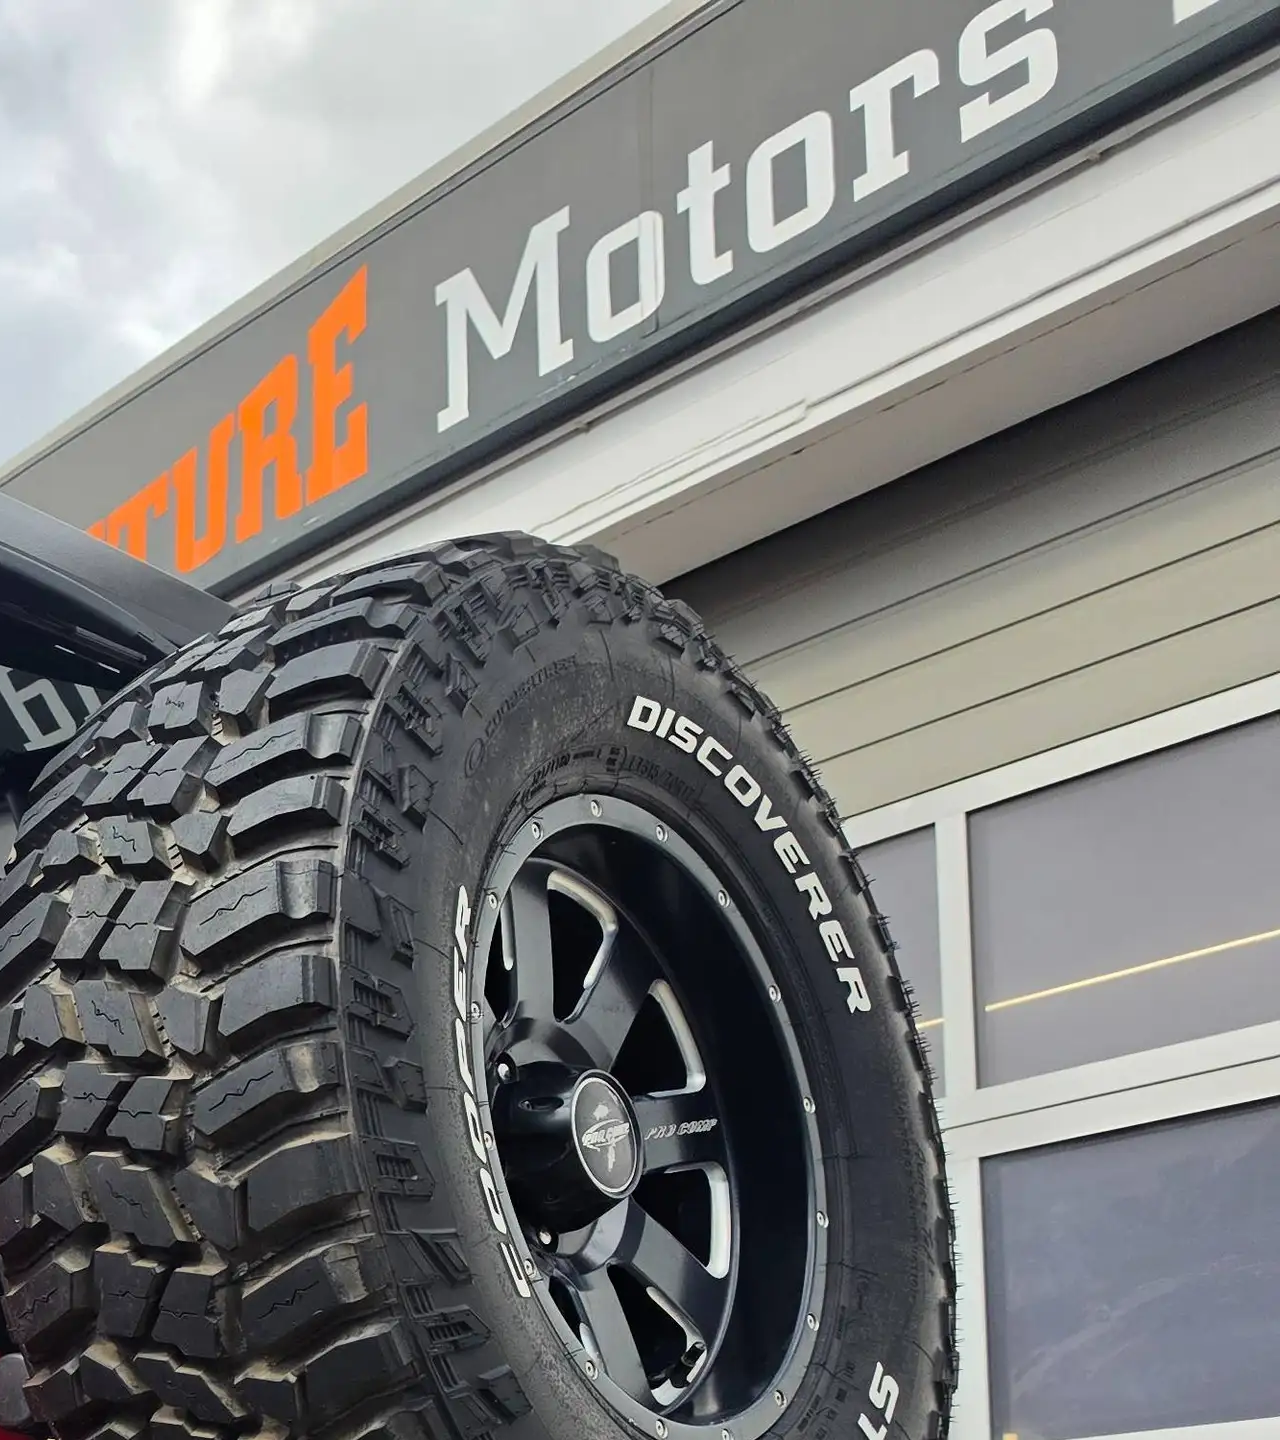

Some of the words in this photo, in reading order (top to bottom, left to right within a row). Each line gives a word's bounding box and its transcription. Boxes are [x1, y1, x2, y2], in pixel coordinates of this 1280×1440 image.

[86, 263, 368, 573] TURE
[435, 0, 1058, 433] Motors
[627, 695, 871, 1014] DISCOVERER
